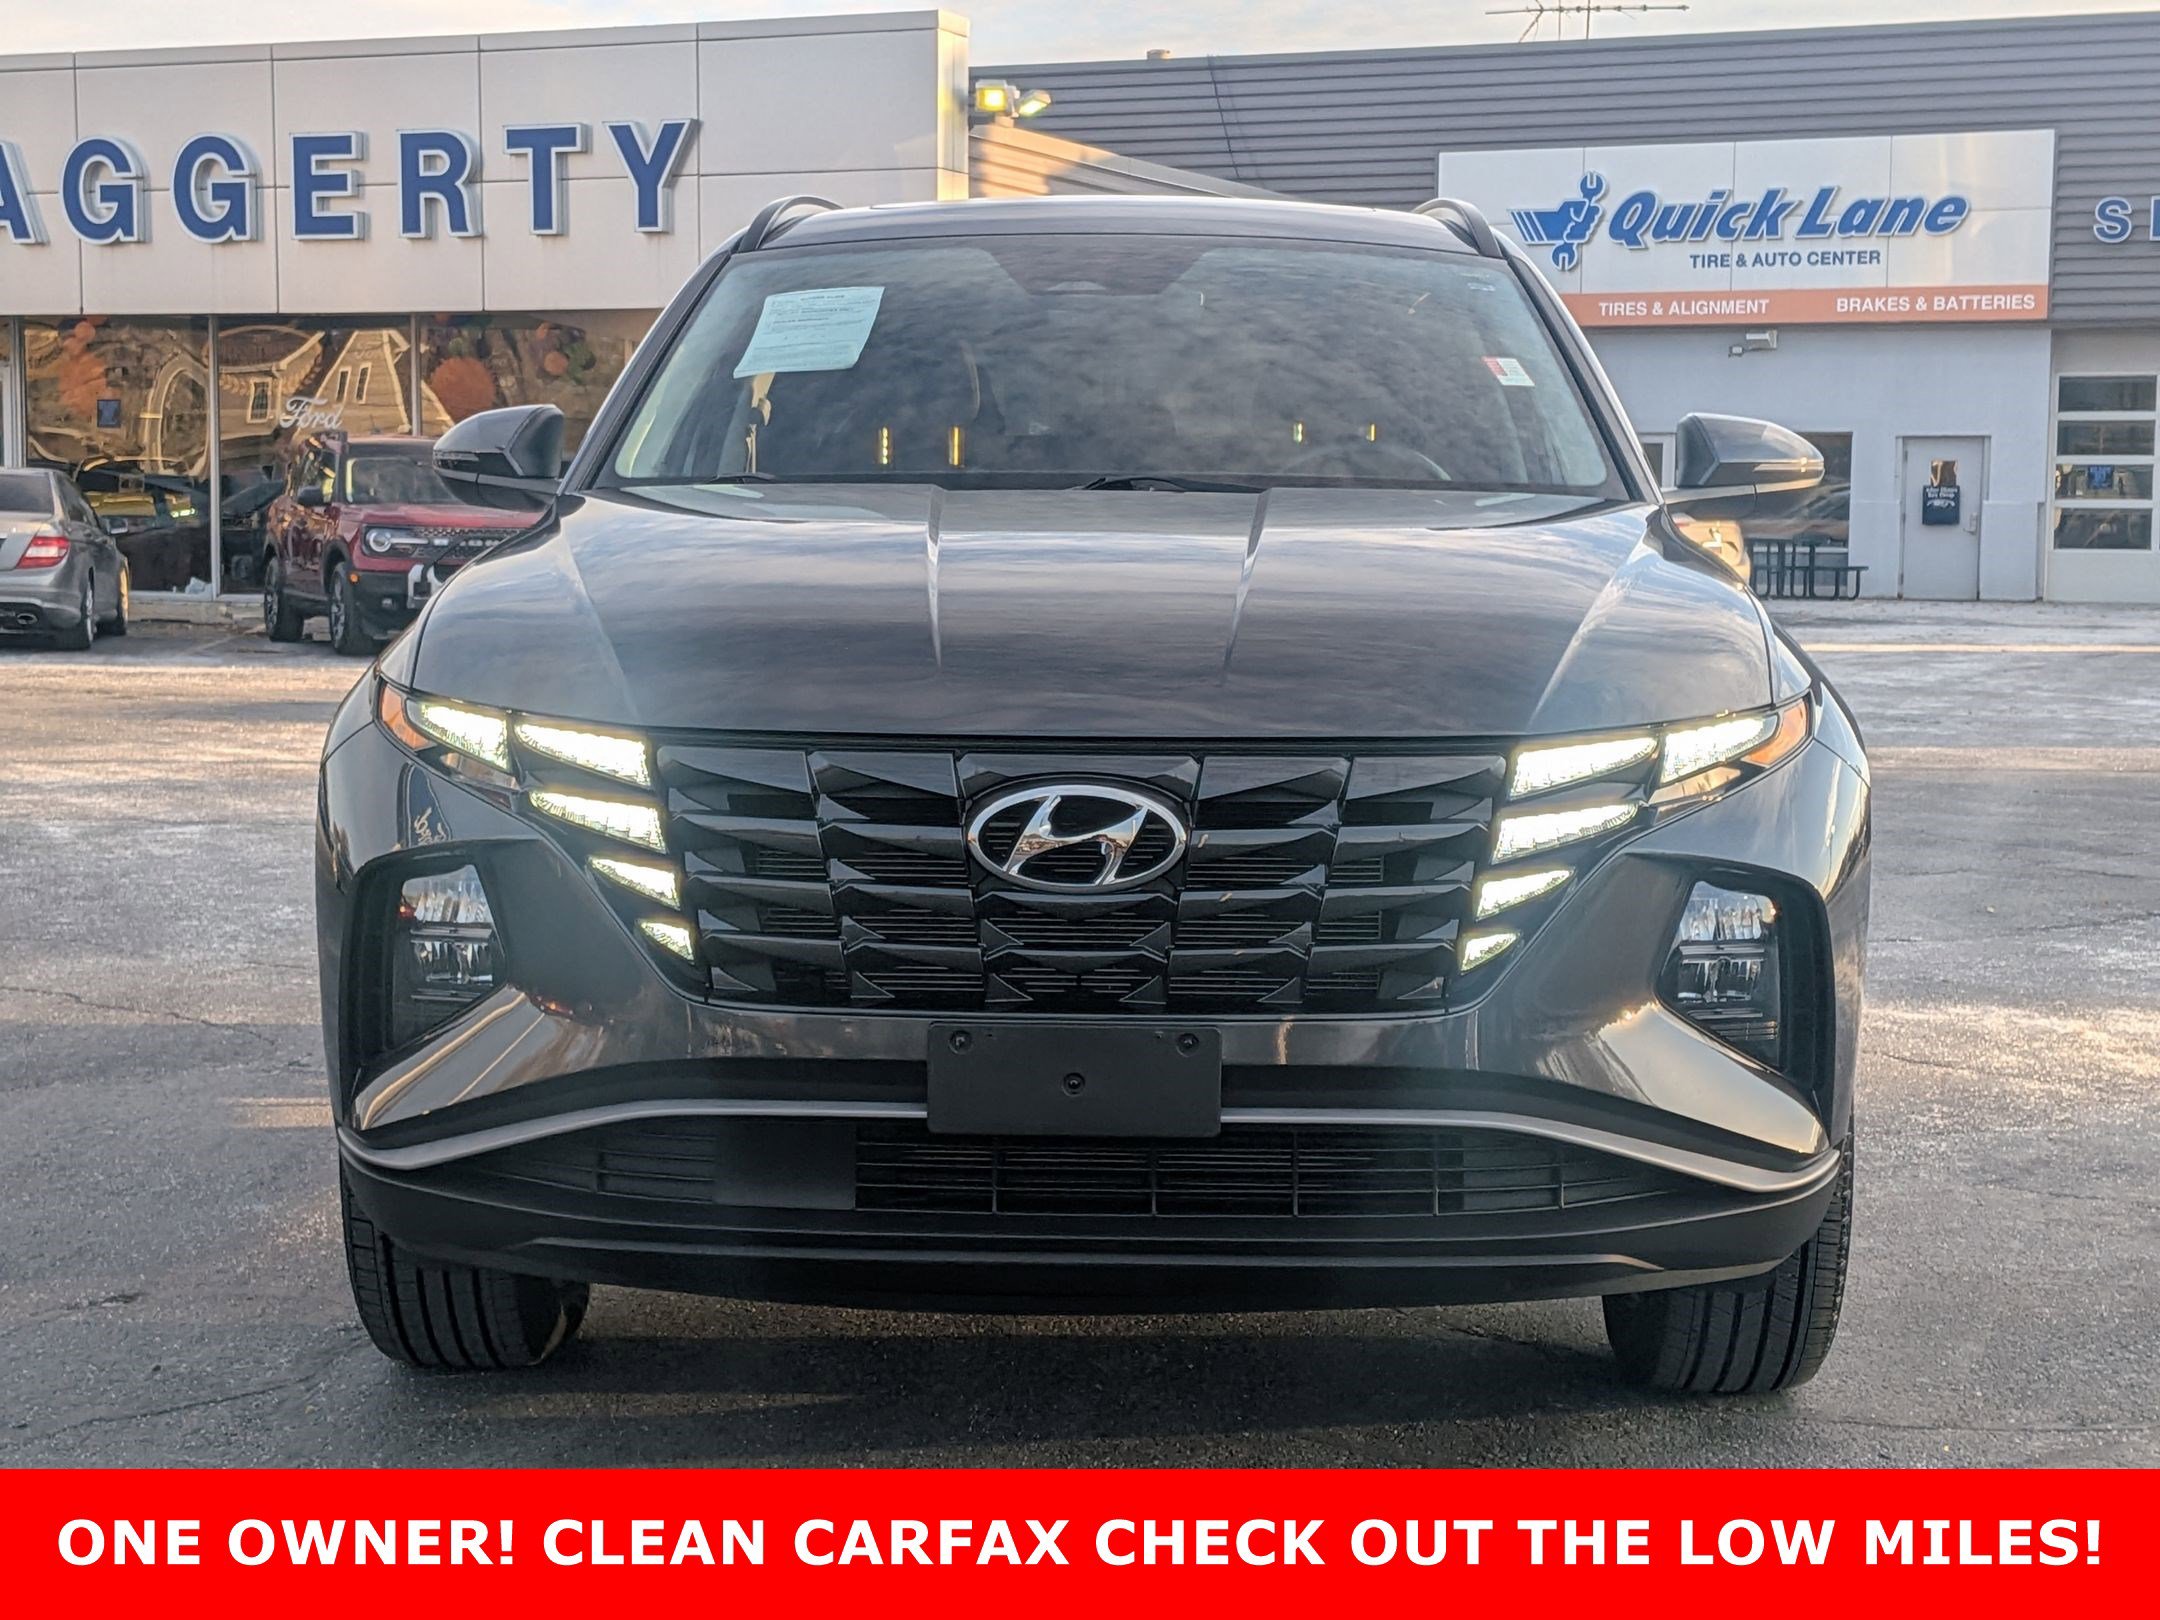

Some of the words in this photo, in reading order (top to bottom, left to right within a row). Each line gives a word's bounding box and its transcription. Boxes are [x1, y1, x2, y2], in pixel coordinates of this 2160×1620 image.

[1608, 188, 1797, 249] Quick
[1795, 186, 1971, 239] Lane
[1690, 253, 1730, 268] TIRE
[1735, 253, 1747, 268] &
[1752, 251, 1802, 267] AUTO
[1807, 250, 1881, 265] CENTER
[1599, 301, 1648, 317] TIRES
[1652, 301, 1664, 316] &
[1668, 298, 1770, 316] ALIGNMENT
[1836, 296, 1910, 313] BRAKES
[1915, 296, 1928, 312] &
[1933, 294, 2036, 311] BATTERIES
[279, 396, 342, 428] Ford
